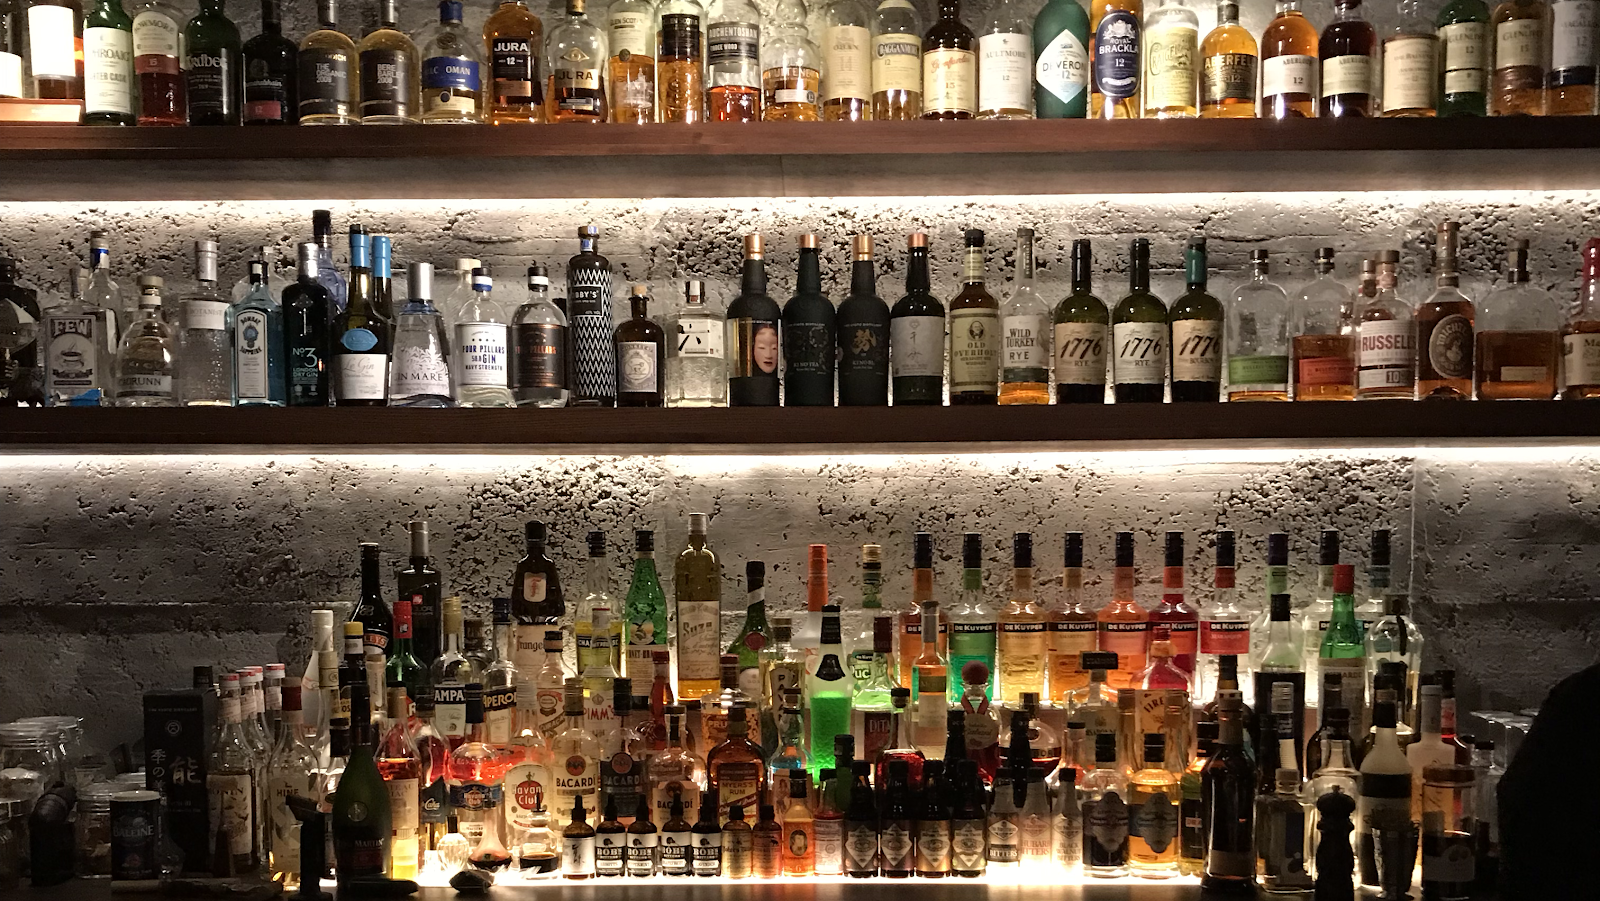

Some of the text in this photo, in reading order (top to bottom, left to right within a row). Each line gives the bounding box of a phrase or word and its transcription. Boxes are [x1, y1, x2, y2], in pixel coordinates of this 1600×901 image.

[494, 42, 529, 52] JURA
[1099, 44, 1138, 55] BRACKLA
[316, 62, 330, 70] THE
[507, 57, 516, 65] 12
[1042, 60, 1086, 72] DVERON
[1115, 58, 1125, 67] 12
[557, 70, 593, 80] JURA
[1062, 70, 1071, 79] 12
[1293, 76, 1304, 85] 12
[240, 316, 261, 325] BOMBAY
[53, 319, 89, 336] FEW
[1009, 328, 1031, 338] WILD
[1004, 336, 1035, 348] TURKEY
[1178, 335, 1222, 357] 1776
[462, 345, 477, 354] FOUR
[479, 345, 505, 354] PILLARS
[1060, 338, 1103, 360] 1776
[1119, 337, 1163, 359] 1776
[953, 349, 997, 358] OVERHOLT
[1009, 351, 1030, 360] RYE
[482, 353, 497, 365] GIN
[1134, 359, 1150, 367] RYE
[410, 373, 442, 382] MARE
[1387, 372, 1399, 383] 10
[964, 623, 993, 632] KUYPER
[1014, 623, 1043, 632] KUYPER
[1068, 623, 1096, 631] KUYPER
[1118, 622, 1147, 631] KUYPER
[1171, 622, 1199, 631] KUYPER
[1221, 622, 1249, 631] KUYPER
[363, 633, 388, 648] LEYS
[516, 635, 545, 652] Frange
[434, 689, 465, 702] AMPA
[556, 773, 596, 788] BACARDÍ
[603, 774, 640, 786] BACARD
[512, 782, 547, 795] Havana
[656, 798, 693, 809] BACDÍ
[989, 849, 1018, 857] BITTERS
